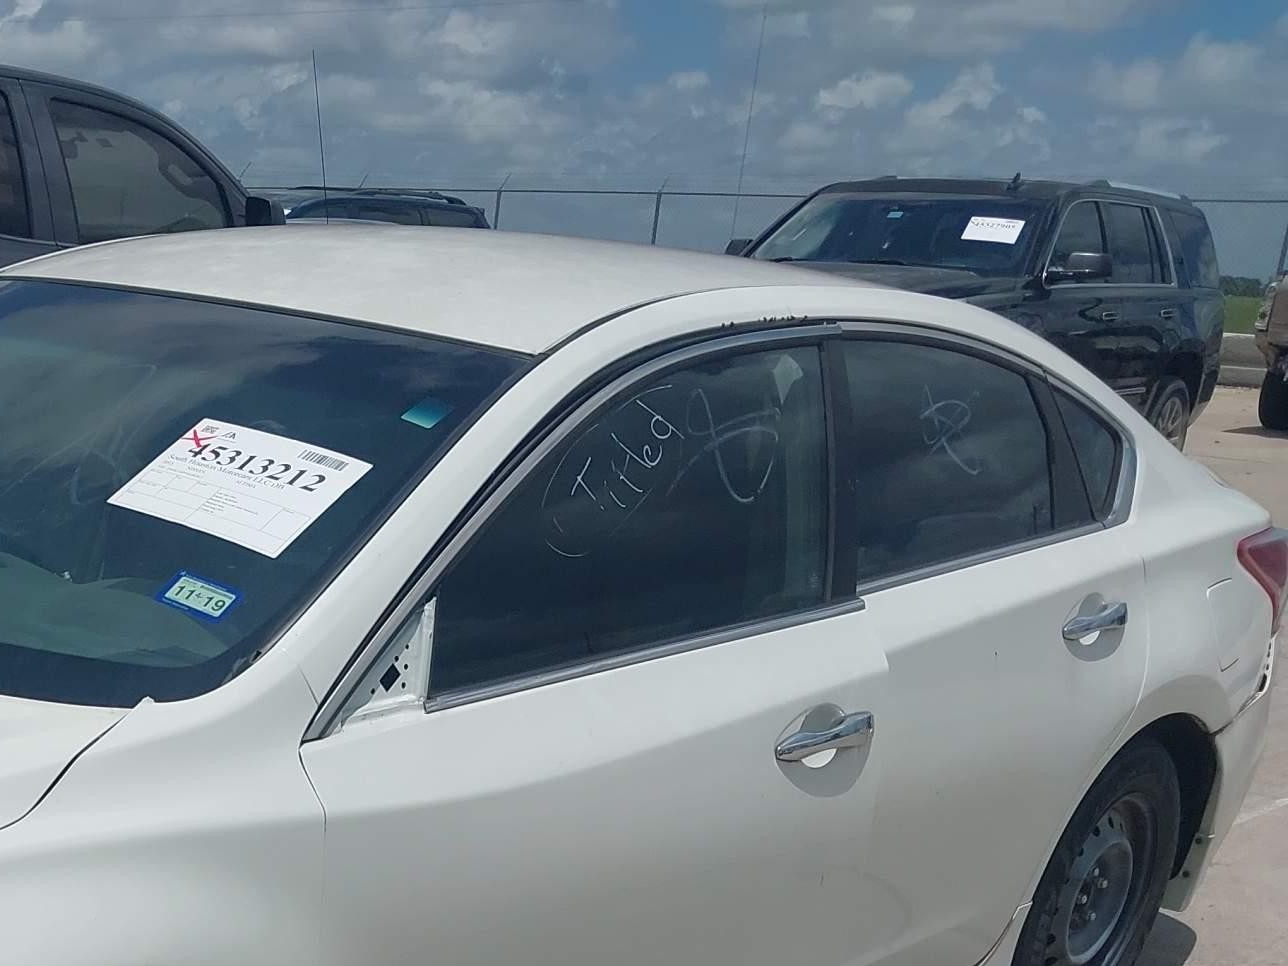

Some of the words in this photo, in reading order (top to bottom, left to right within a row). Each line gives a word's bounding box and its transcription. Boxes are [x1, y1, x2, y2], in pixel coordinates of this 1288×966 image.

[188, 443, 326, 492] 45313212
[174, 585, 196, 601] 11
[203, 596, 227, 612] 19
